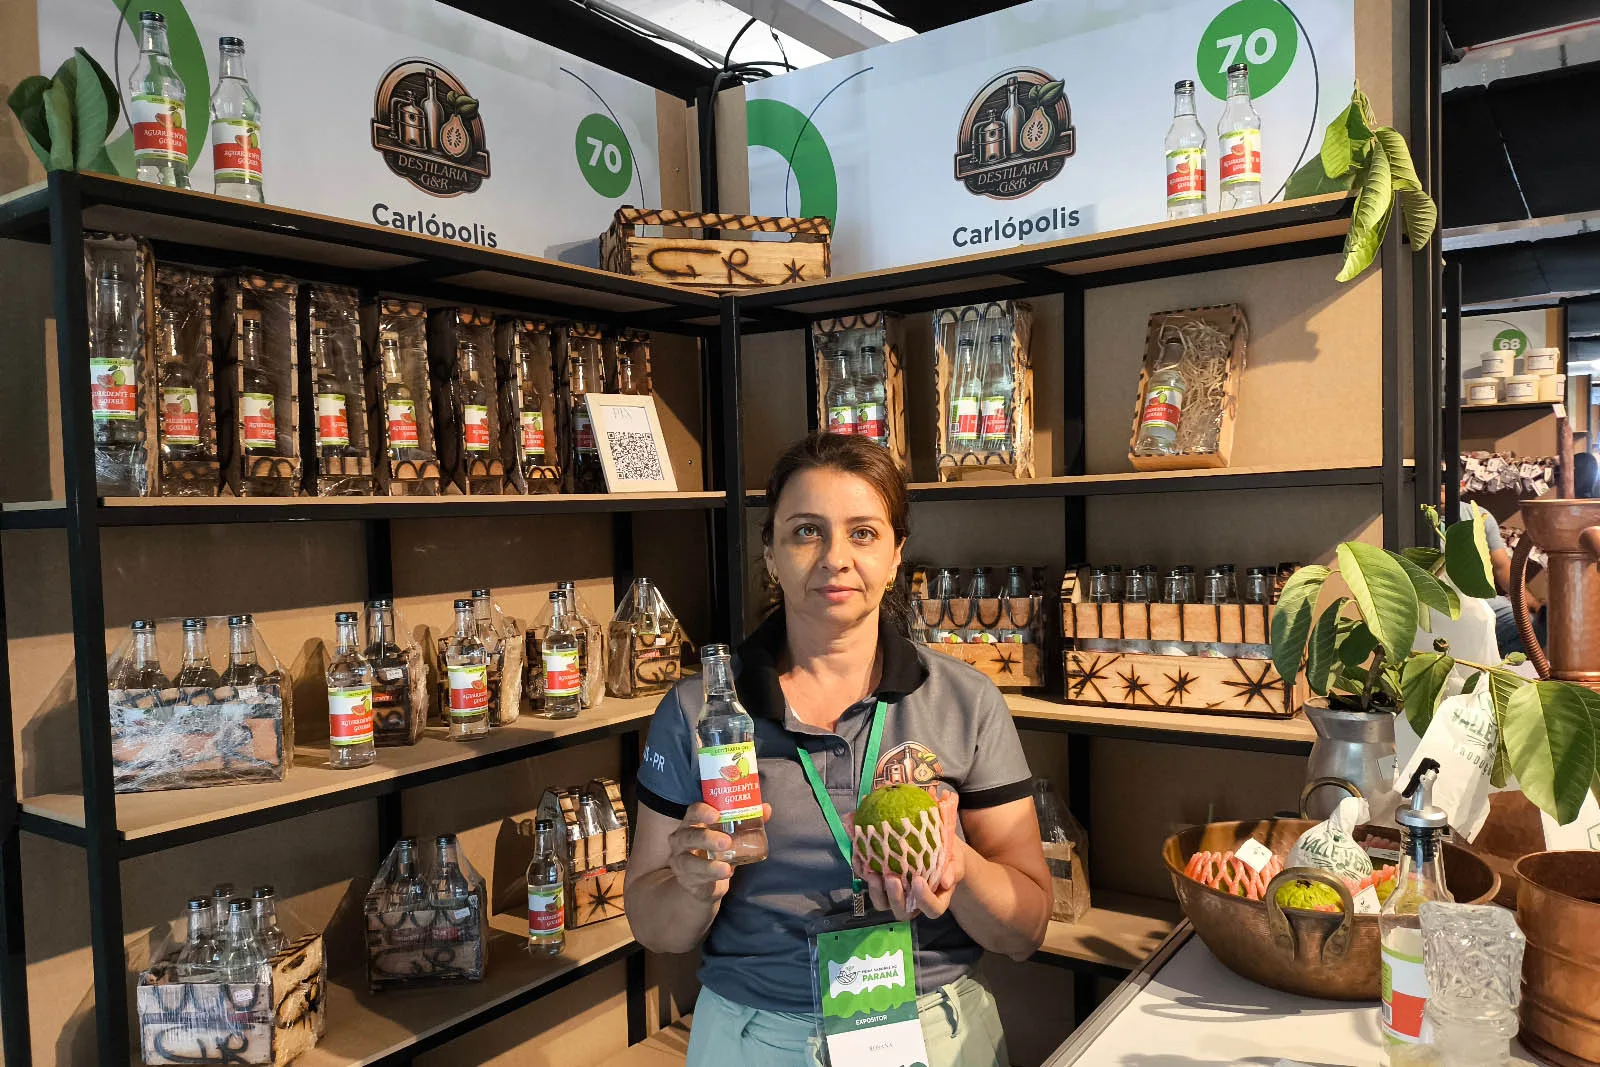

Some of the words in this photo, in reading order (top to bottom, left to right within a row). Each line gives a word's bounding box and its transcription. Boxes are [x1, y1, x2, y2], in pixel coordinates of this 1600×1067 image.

[1216, 27, 1278, 74] 70
[398, 155, 469, 183] DESTILARIA
[586, 136, 622, 175] 70
[978, 161, 1049, 185] DESTILARIA
[372, 203, 498, 249] Carlópolis
[952, 206, 1080, 248] Carlópolis
[1499, 338, 1521, 350] 68
[855, 1014, 888, 1026] EXPOSITOR
